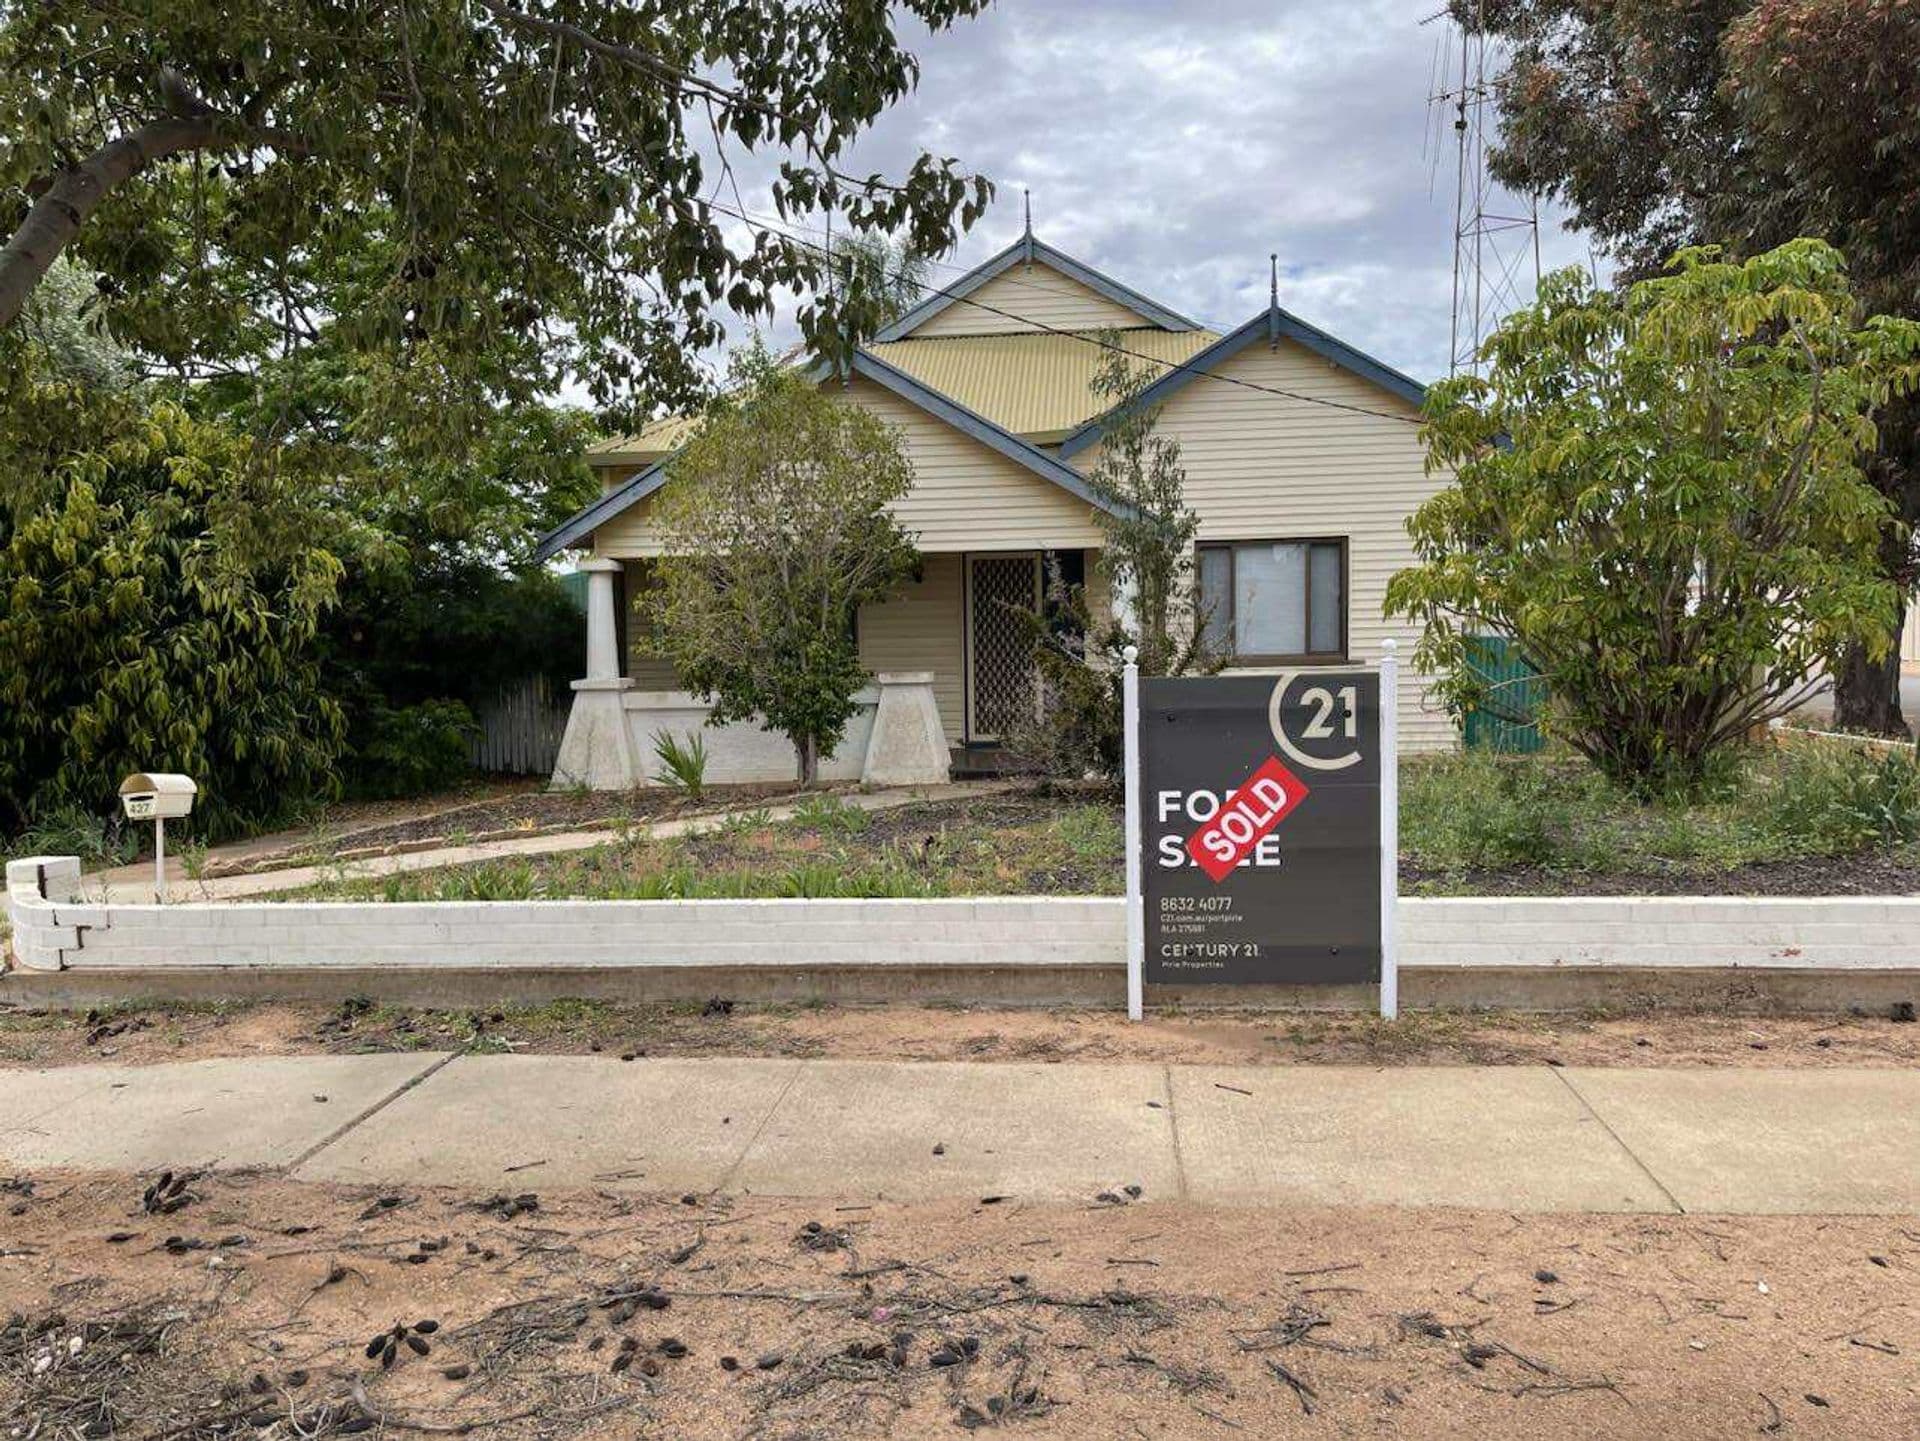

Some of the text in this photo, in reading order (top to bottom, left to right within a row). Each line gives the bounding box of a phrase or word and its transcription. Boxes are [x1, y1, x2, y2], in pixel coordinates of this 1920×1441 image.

[1300, 686, 1357, 738] 21
[1158, 789, 1241, 822] FO
[1203, 778, 1288, 862] SOLD
[1158, 834, 1281, 868] SE
[1160, 896, 1233, 912] 8632 4077
[1161, 943, 1240, 957] CENTURY
